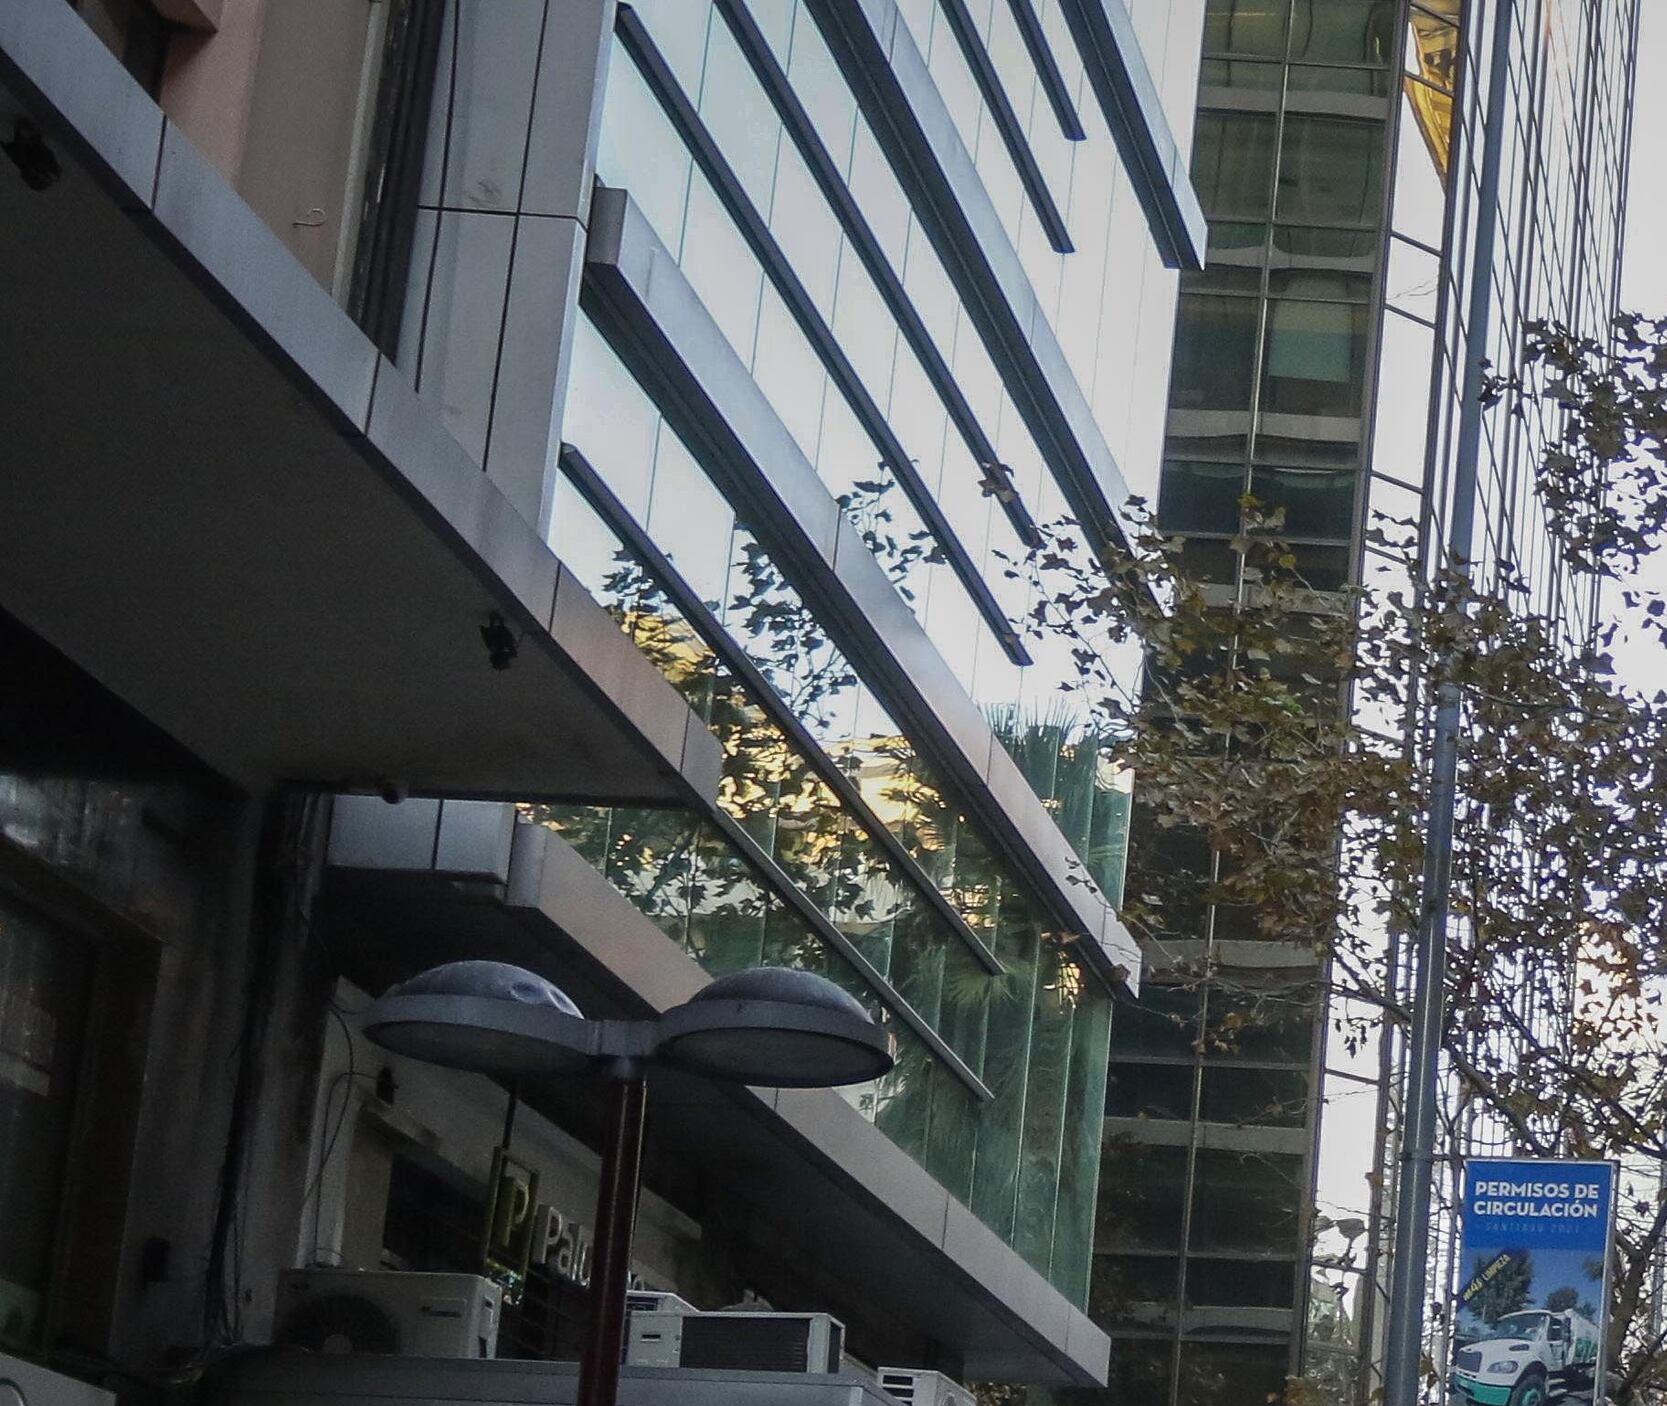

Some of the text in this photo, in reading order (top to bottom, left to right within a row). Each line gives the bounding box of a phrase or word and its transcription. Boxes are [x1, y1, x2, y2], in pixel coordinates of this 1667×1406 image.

[1475, 1181, 1600, 1199] PERMISOS DE
[1473, 1200, 1598, 1218] CIRCULACIÓN
